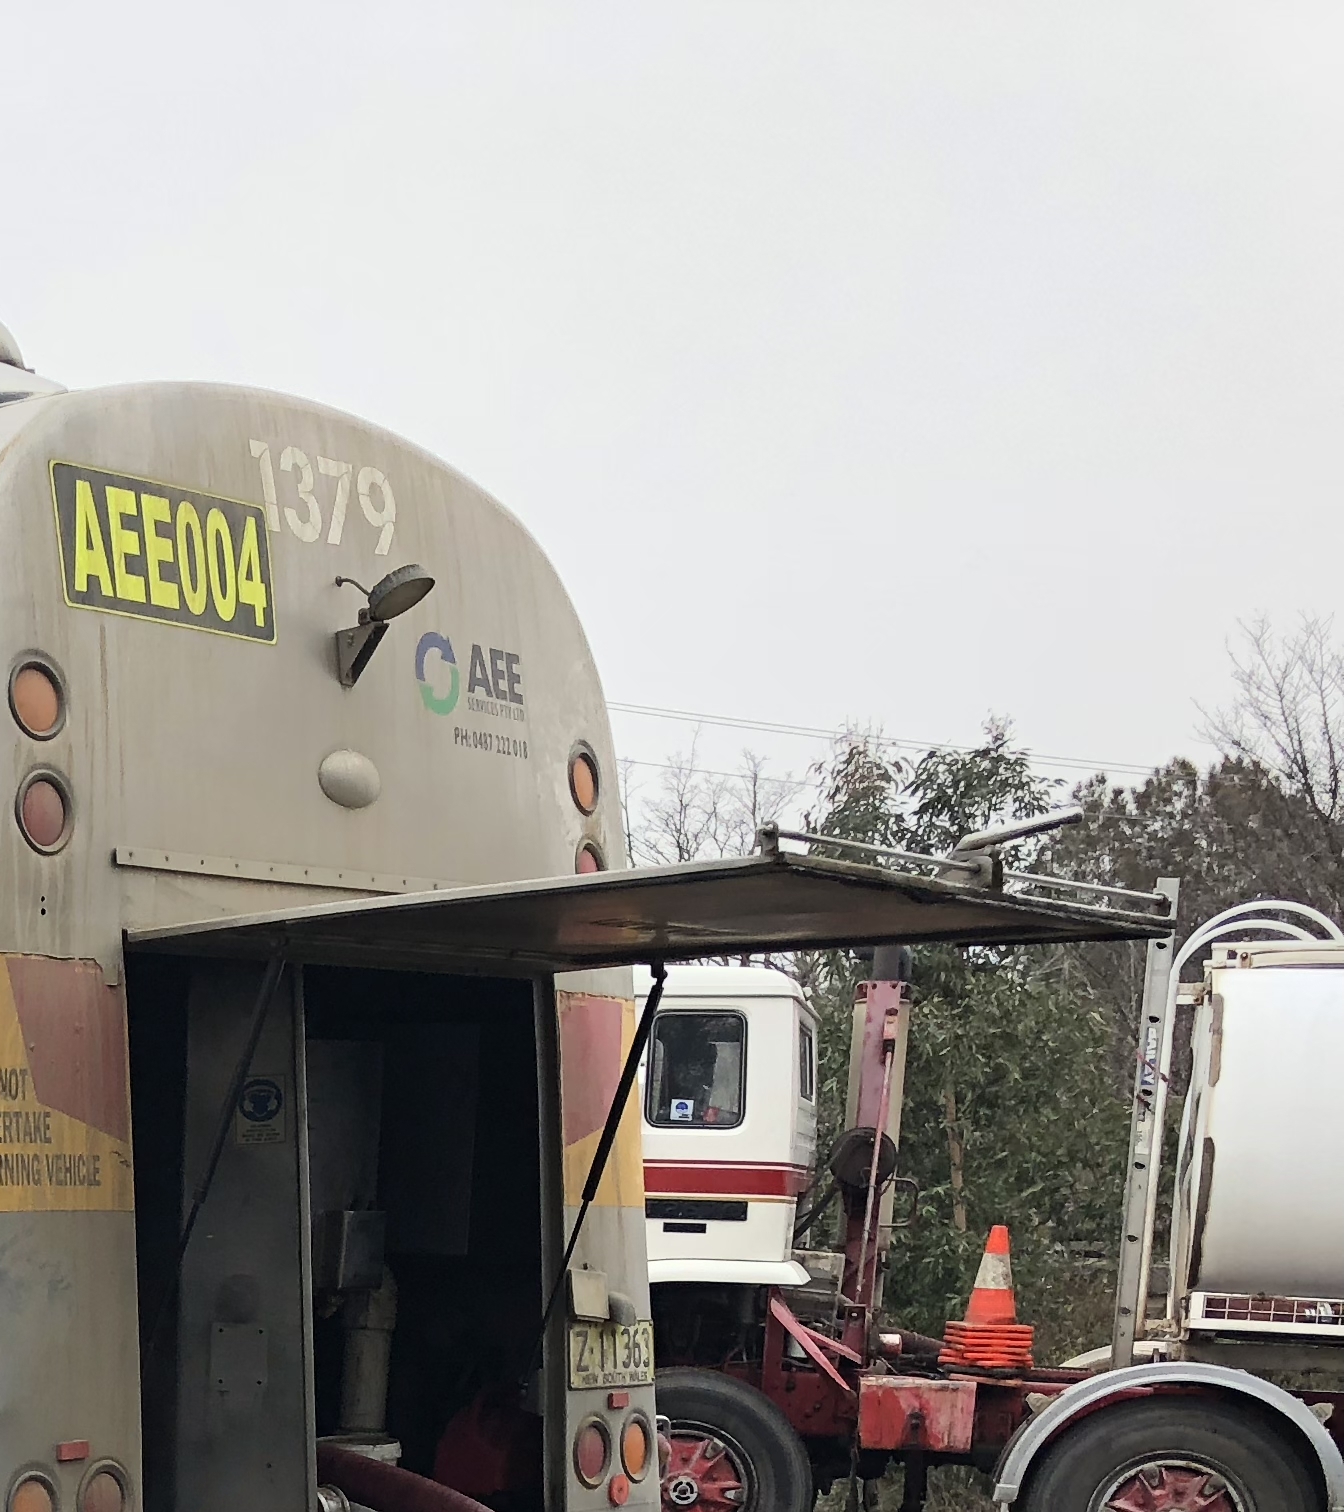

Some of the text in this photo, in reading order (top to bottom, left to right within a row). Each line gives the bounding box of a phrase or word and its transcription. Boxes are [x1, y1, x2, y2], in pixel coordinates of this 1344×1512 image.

[249, 439, 398, 556] 1379
[73, 479, 268, 628] AEE004
[467, 643, 524, 706] AEE
[467, 697, 525, 722] SERVICES PTY LTD
[495, 735, 512, 756] 222
[512, 739, 528, 759] 018
[45, 1153, 102, 1187] VEHICLE
[582, 1370, 648, 1385] NEW SOUTH WALES
